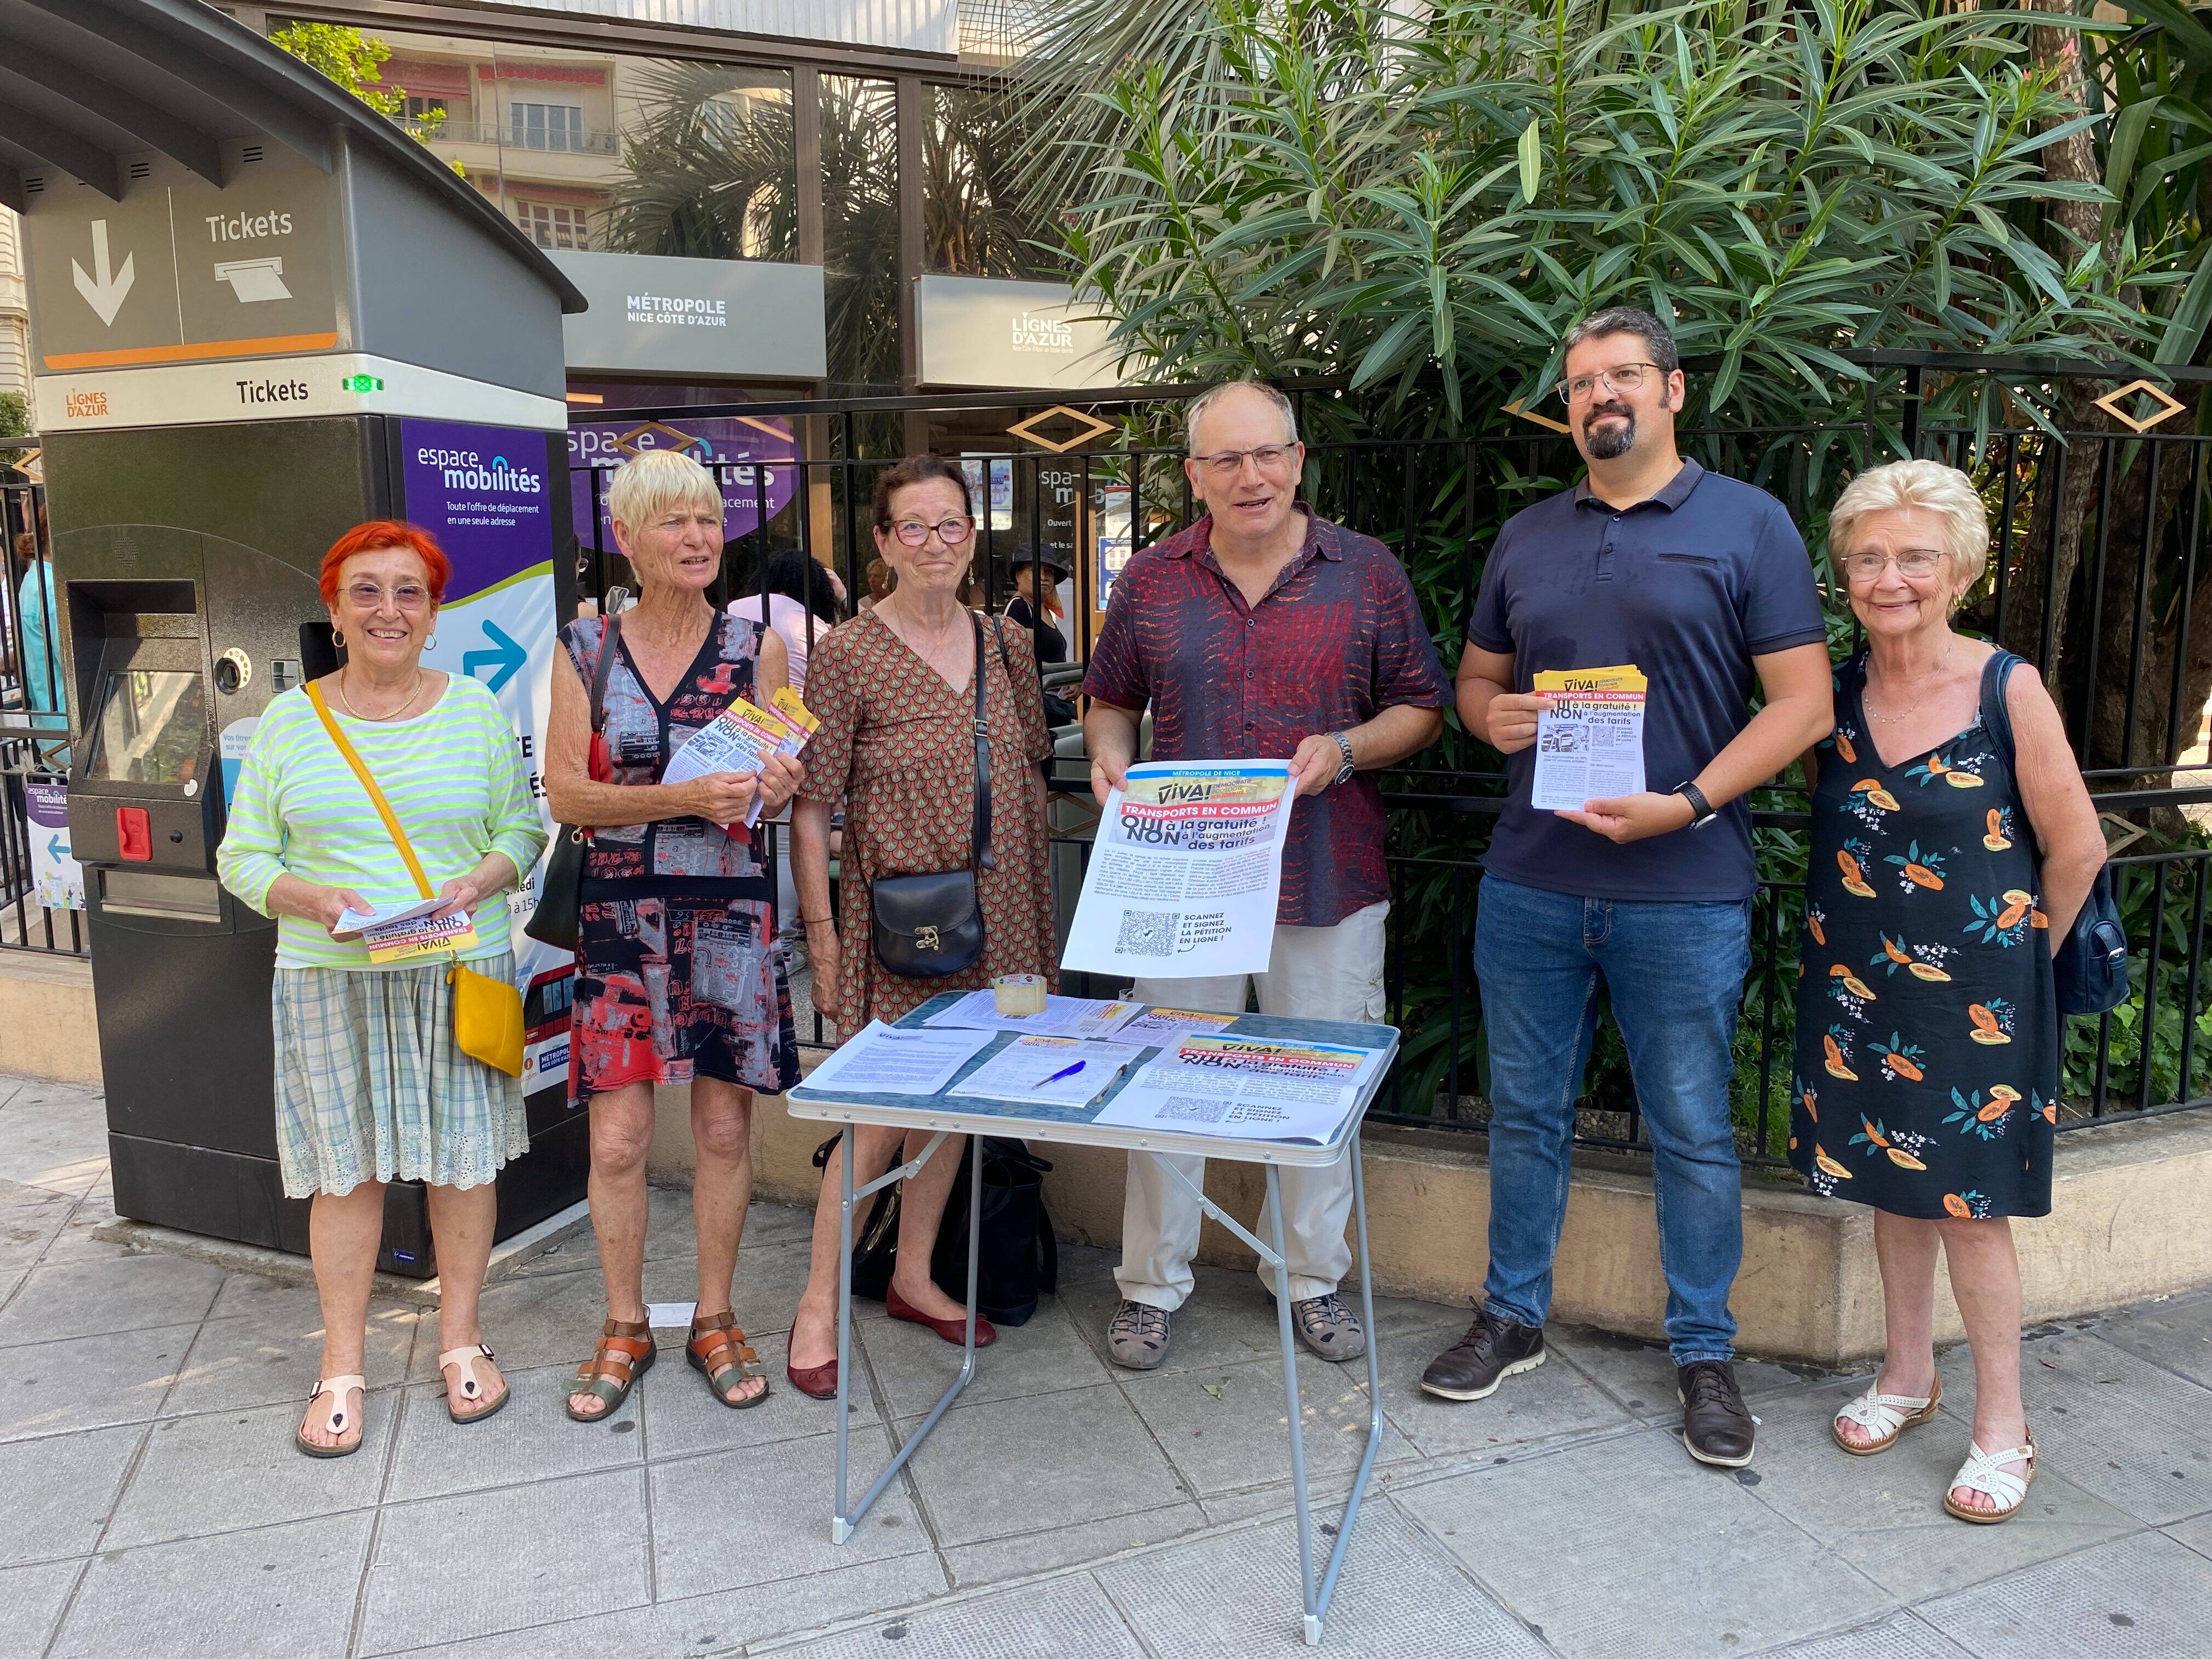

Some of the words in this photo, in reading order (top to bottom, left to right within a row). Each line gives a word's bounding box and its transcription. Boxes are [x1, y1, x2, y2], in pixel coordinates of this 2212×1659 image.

[206, 210, 293, 242] Tickets
[627, 292, 725, 314] MÉTROPOLE
[628, 312, 654, 323] NICE
[657, 312, 685, 324] CÔTE
[688, 315, 726, 326] D'AZUR
[1012, 312, 1072, 333] LIGNES
[1013, 332, 1073, 347] D'AZUR
[66, 388, 107, 407] LIGNES
[236, 378, 308, 404] Tickets
[67, 404, 109, 417] D'AZUR
[418, 448, 478, 471] espace
[444, 465, 540, 493] mobilités
[446, 501, 466, 511] Toute
[467, 502, 487, 512] l'offre
[488, 503, 496, 512] de
[498, 503, 539, 514] déplacement
[472, 516, 489, 525] seule
[490, 517, 515, 526] adresse
[1557, 700, 1570, 710] UI
[1593, 703, 1630, 711] gratuité
[724, 710, 755, 730] TRANSPORTS
[1550, 709, 1582, 719] NON
[715, 723, 739, 741] NON
[719, 716, 738, 730] OUI
[746, 735, 769, 750] gratuité
[736, 743, 747, 752] des
[37, 793, 67, 804] mobilité
[1125, 805, 1199, 818] TRANSPORTS
[1202, 806, 1217, 815] EN
[1221, 802, 1277, 815] COMMUN
[1121, 815, 1163, 832] OUI
[1166, 820, 1176, 831] à
[1181, 820, 1194, 830] la
[1198, 817, 1257, 832] gratuité
[1262, 816, 1267, 824] !
[1126, 827, 1180, 845] NON
[1182, 831, 1188, 839] à
[1192, 824, 1270, 840] l'augmentation
[1188, 840, 1215, 850] des
[1220, 836, 1255, 849] tarifs
[380, 929, 417, 941] gratuité
[420, 928, 467, 939] TRANSPORTS
[1194, 927, 1232, 935] PÉTITION
[369, 940, 407, 949] COMMUN
[541, 1047, 569, 1063] MÉTROPOL
[1184, 1049, 1266, 1060] TRANSPORTS
[1289, 1058, 1353, 1068] COMMUN
[1183, 1059, 1242, 1069] NON
[1261, 1062, 1328, 1072] gratuité
